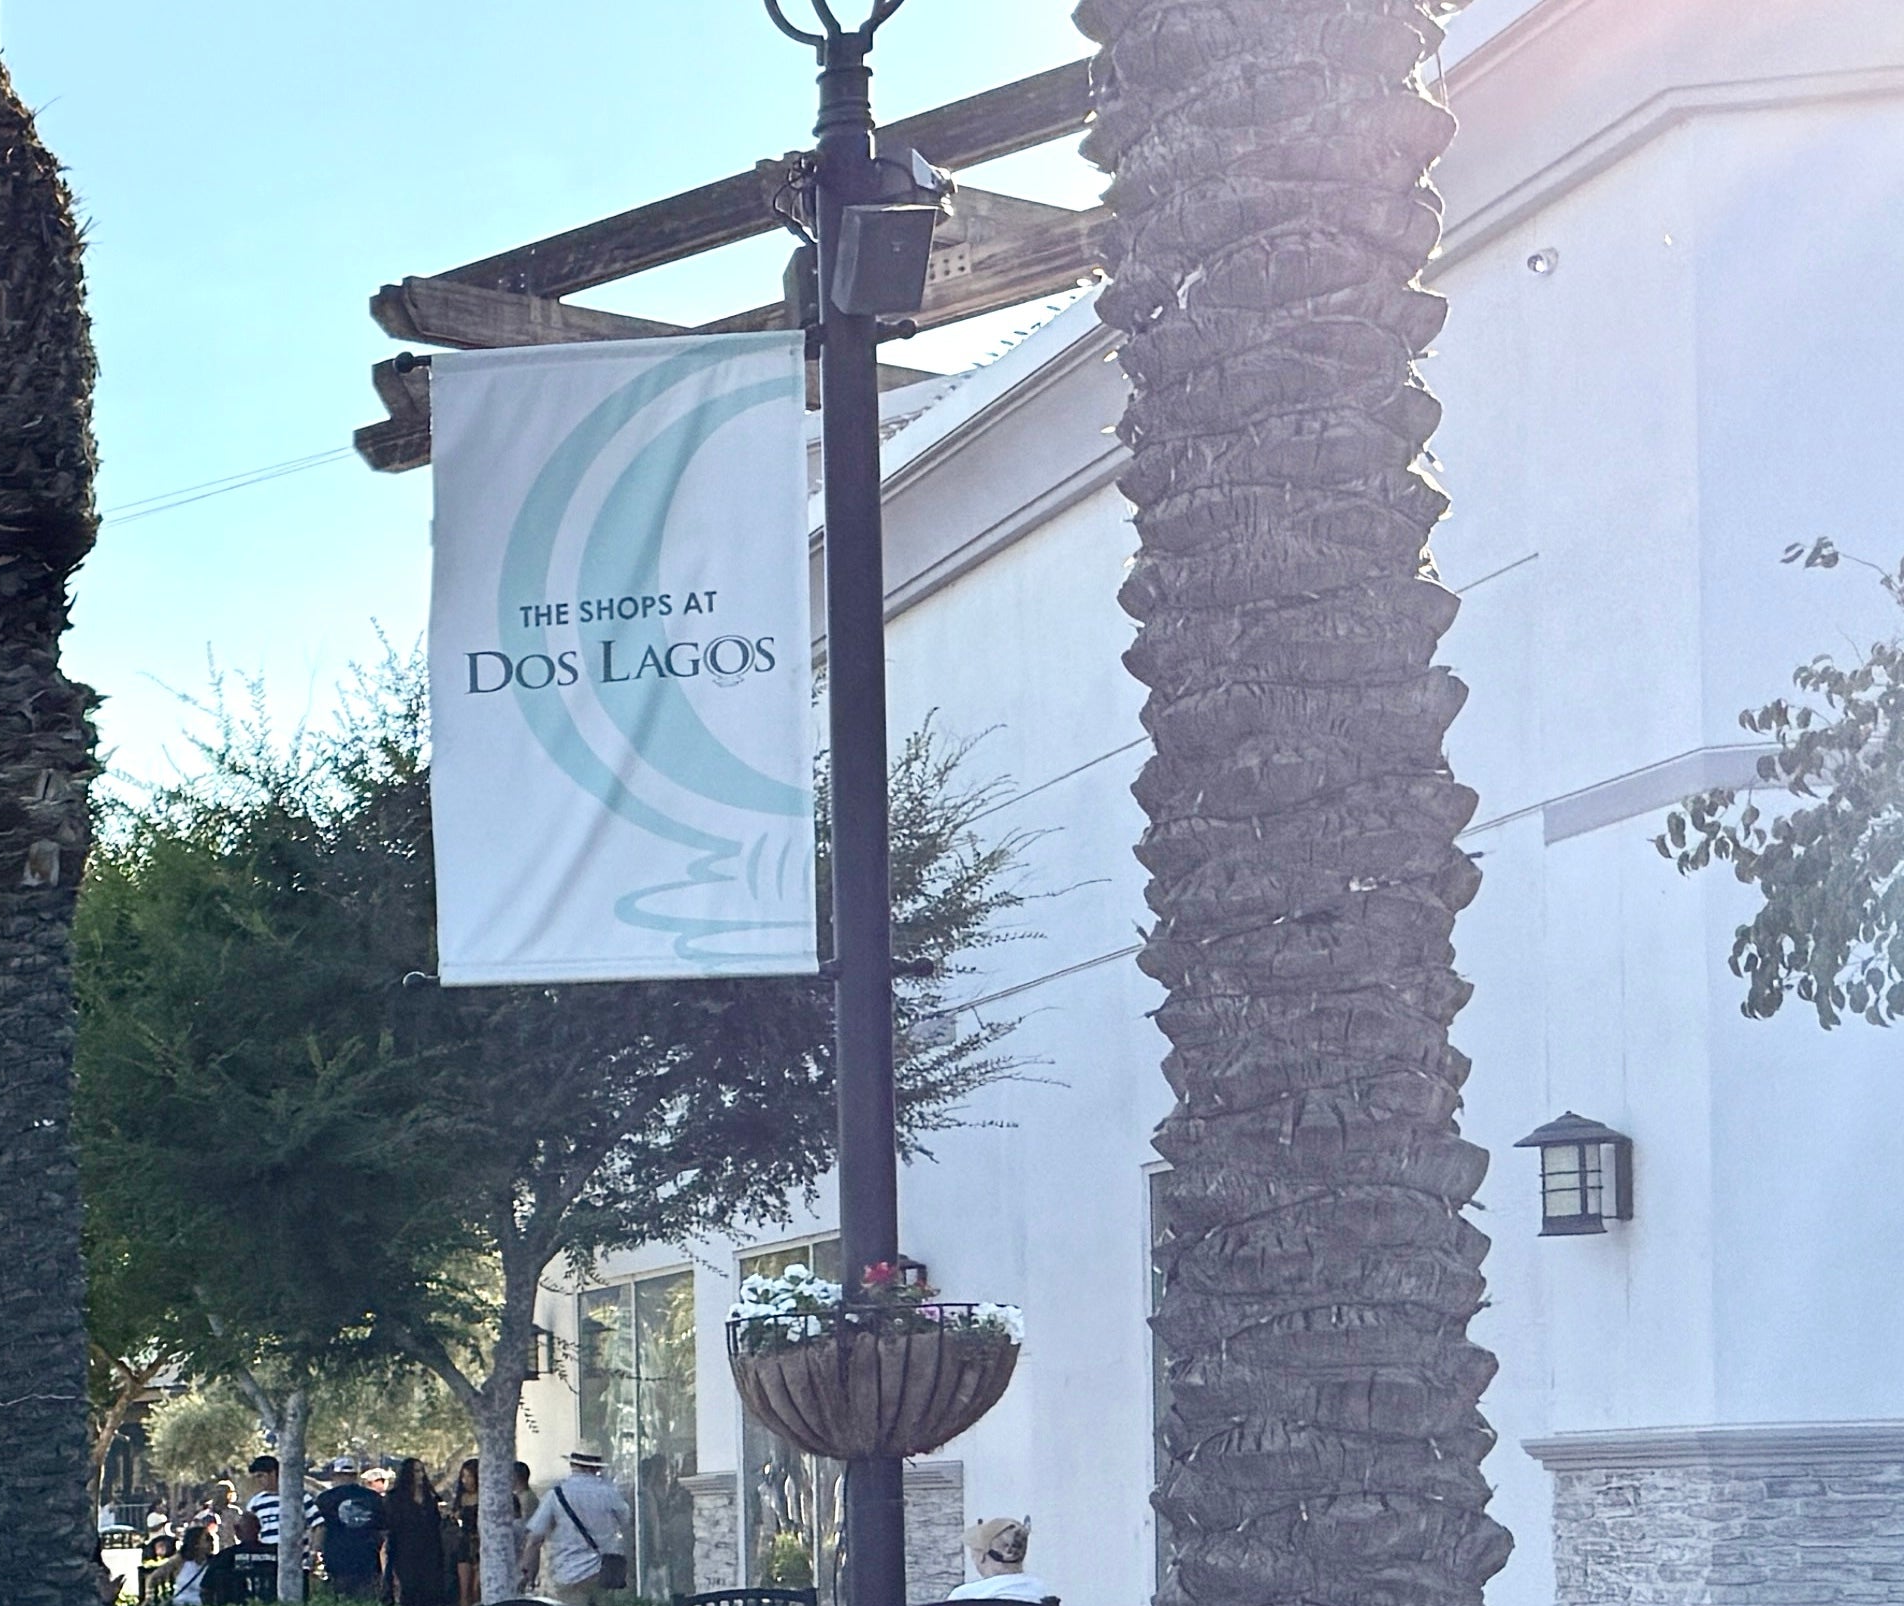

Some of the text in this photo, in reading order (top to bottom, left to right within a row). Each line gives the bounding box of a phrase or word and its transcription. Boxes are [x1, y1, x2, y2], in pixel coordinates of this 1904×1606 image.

[520, 591, 717, 628] THE SHOPS AT
